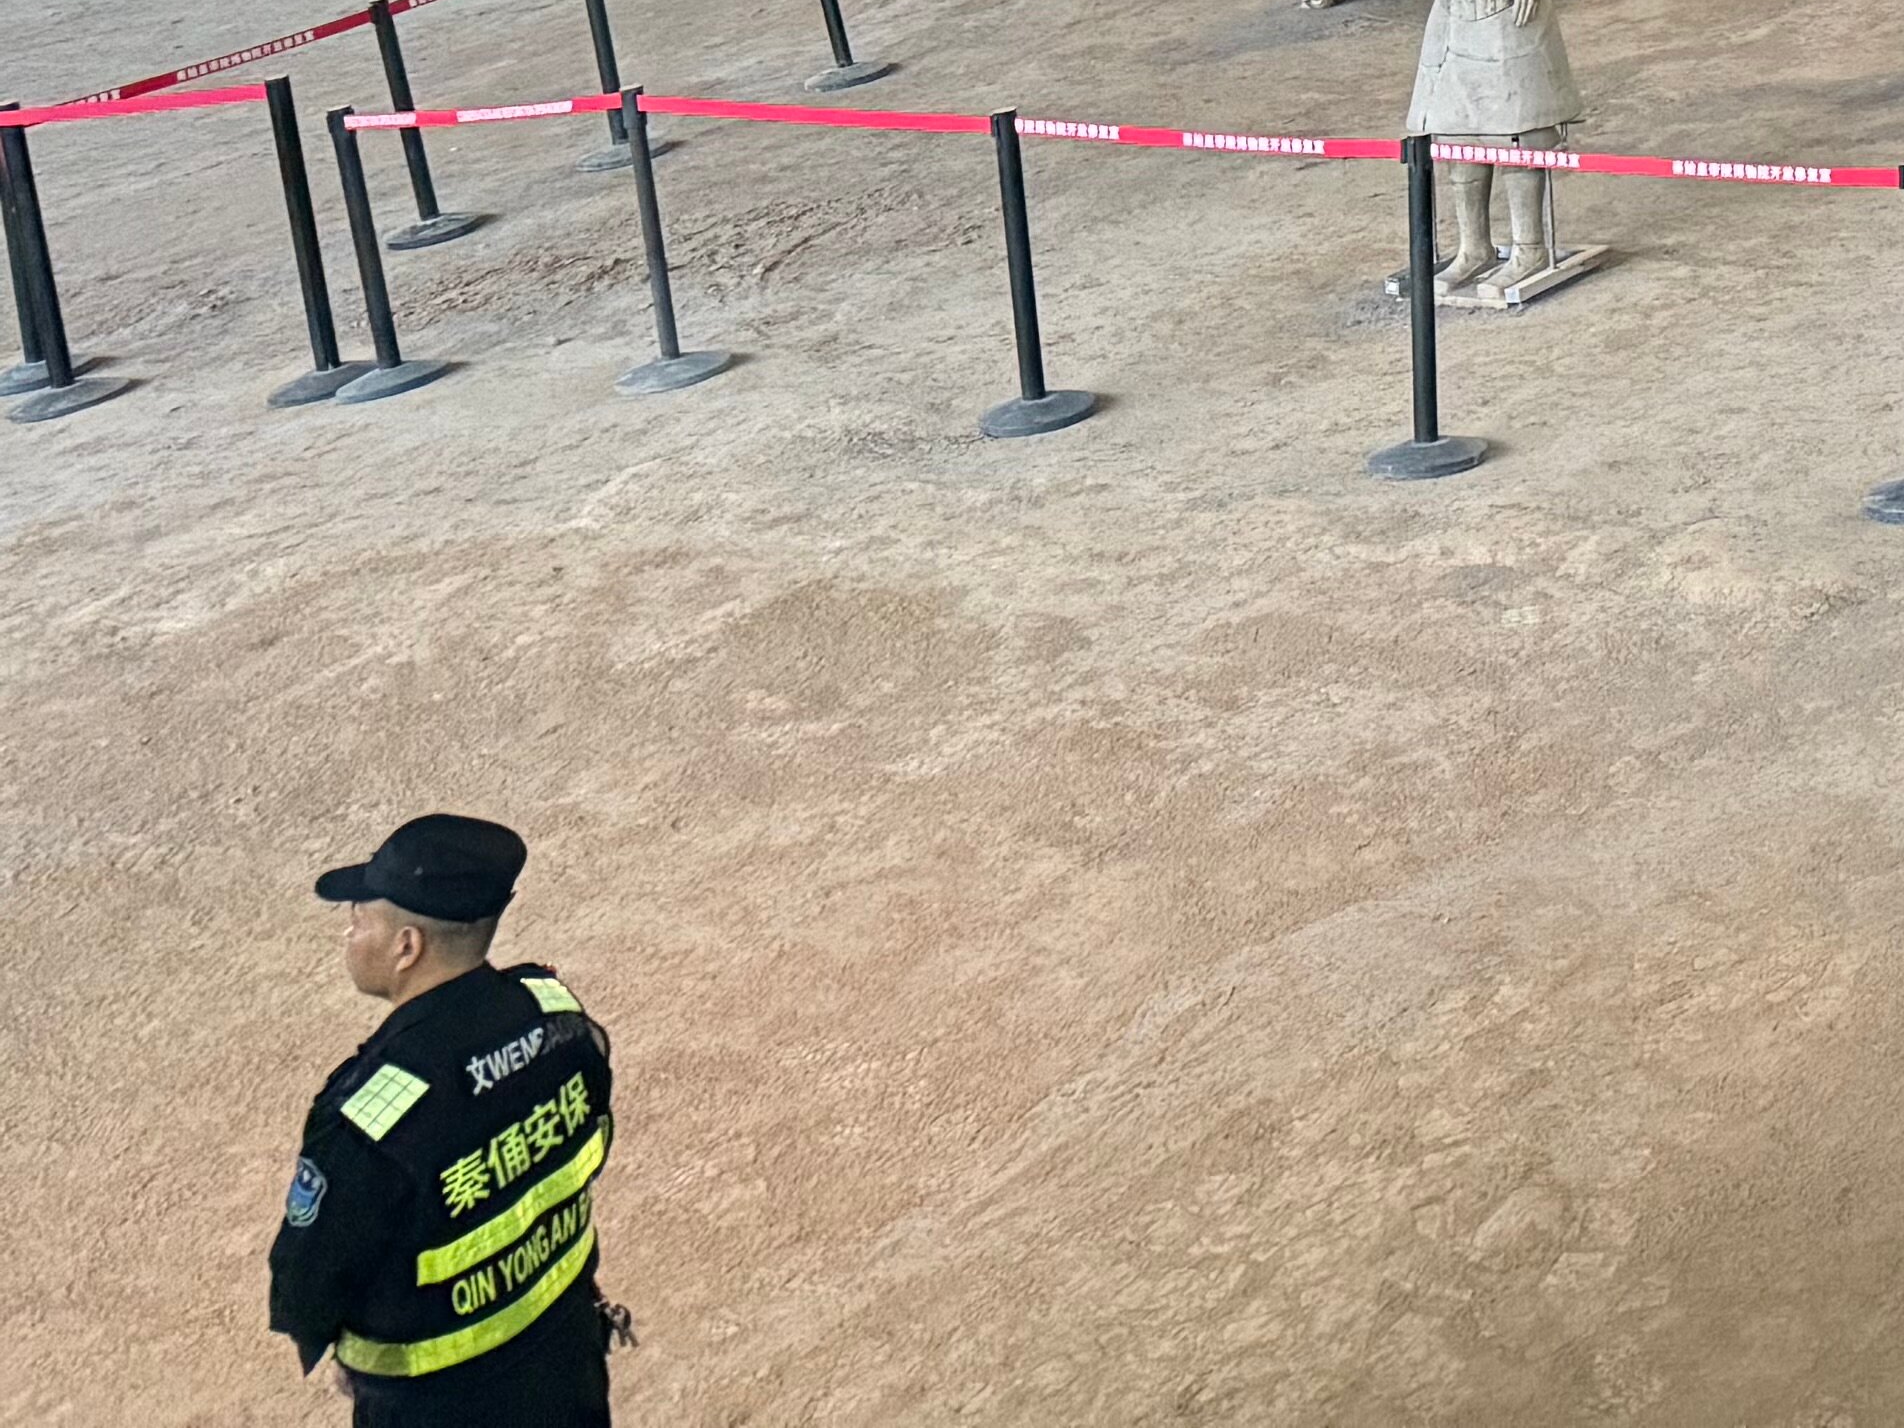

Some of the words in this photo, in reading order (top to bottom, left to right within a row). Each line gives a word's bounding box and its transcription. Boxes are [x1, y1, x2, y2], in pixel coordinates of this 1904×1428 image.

[440, 1070, 591, 1218] 秦俑安保
[451, 1265, 497, 1315] QIN
